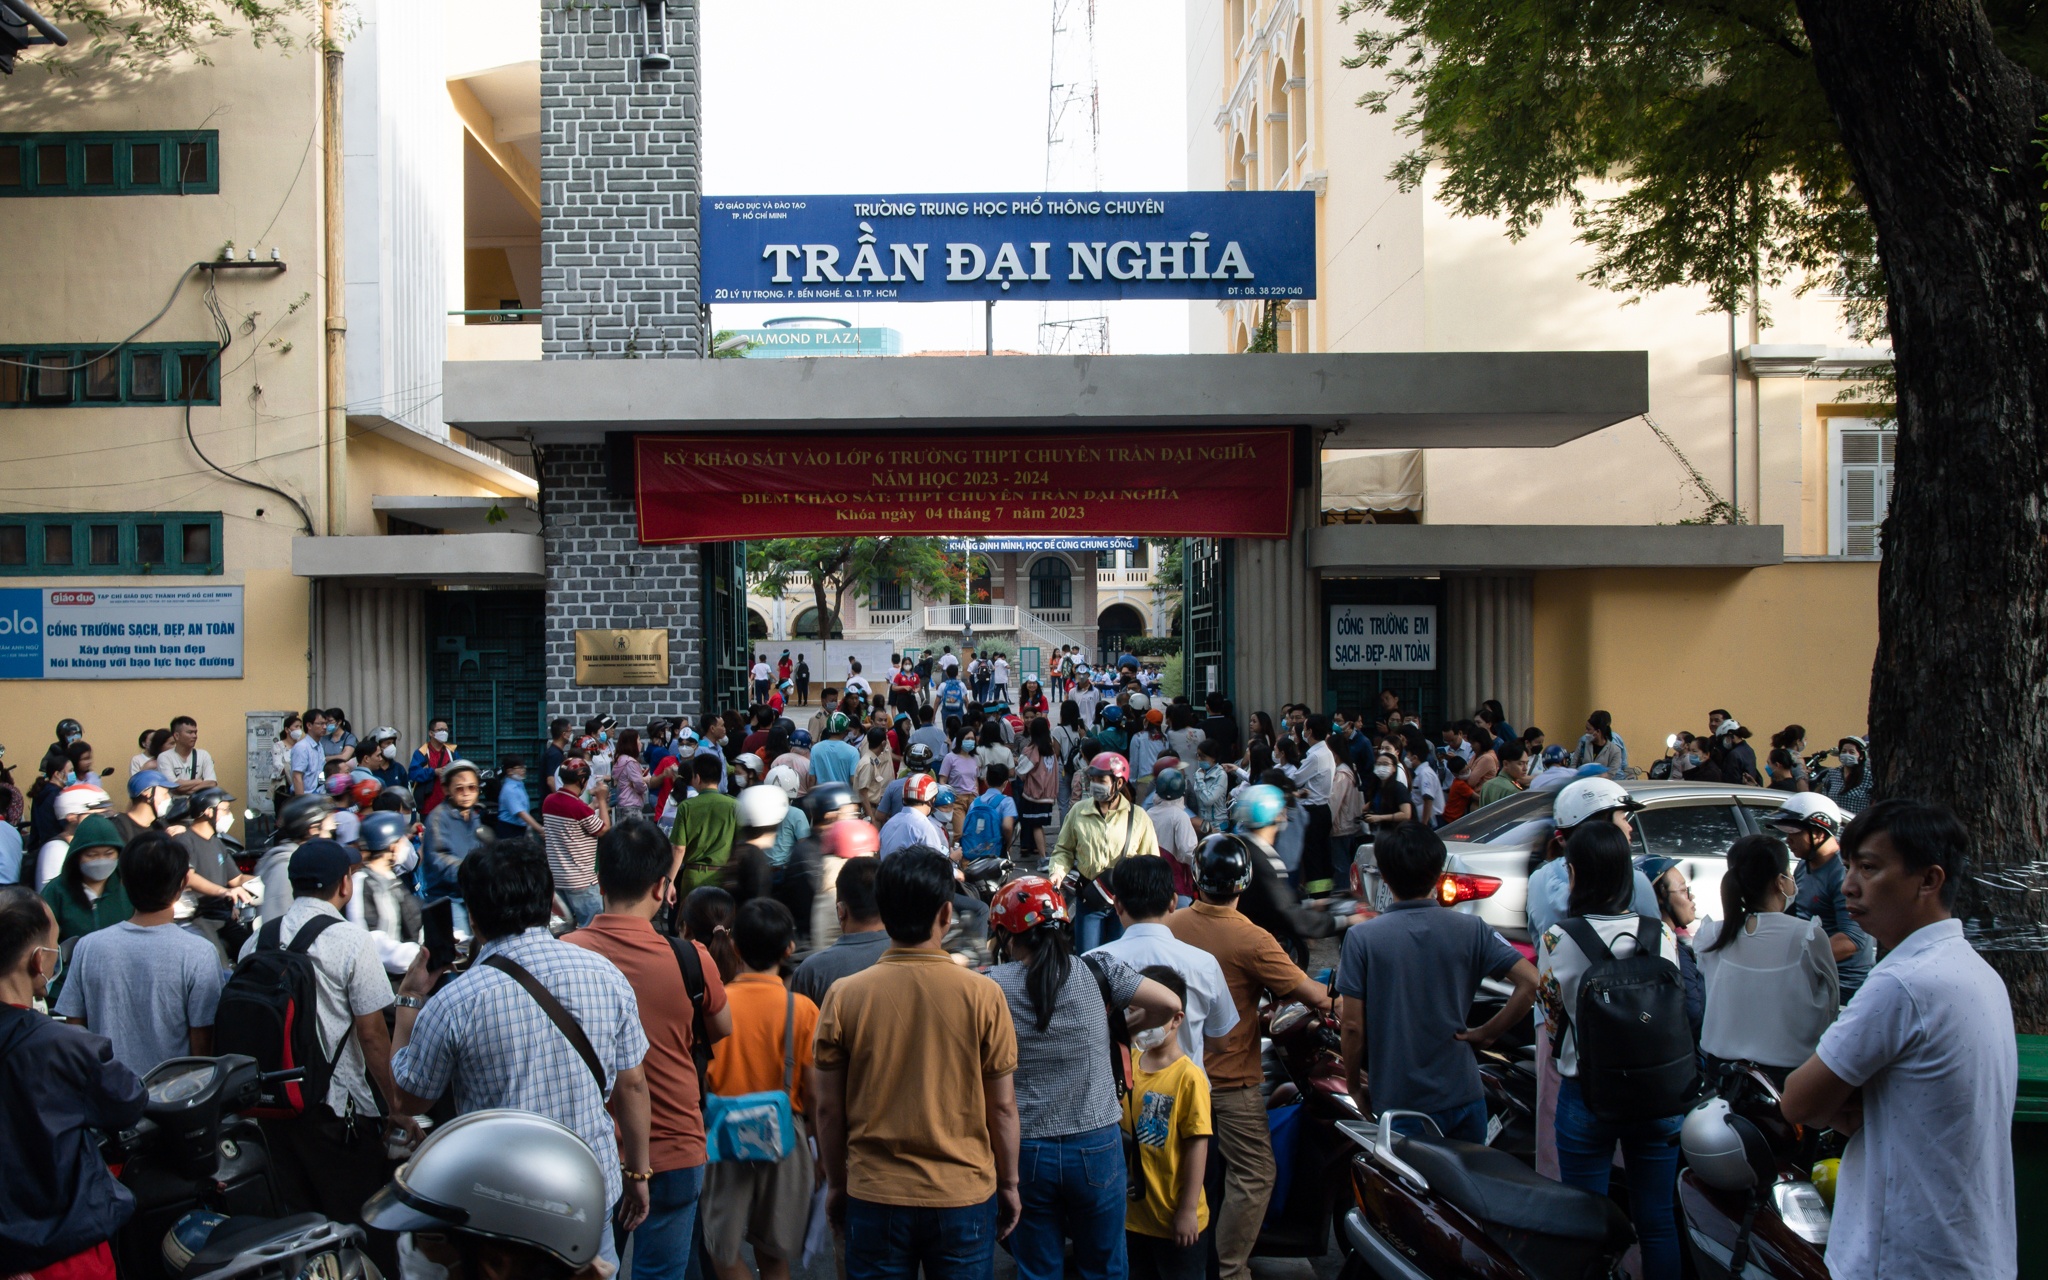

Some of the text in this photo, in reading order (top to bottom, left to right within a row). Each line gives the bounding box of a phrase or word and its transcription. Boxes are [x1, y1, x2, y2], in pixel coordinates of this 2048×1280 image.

[725, 201, 745, 210] GIÁO
[746, 202, 761, 211] DỤC
[762, 201, 773, 209] VÀ
[774, 201, 790, 209] ĐÀO
[792, 202, 807, 211] TẠO
[854, 195, 1165, 218] TRƯỜNG TRUNG HỌC PHỔ THÔNG CHUYÊN
[732, 212, 741, 220] TP.
[755, 210, 768, 220] CHÍ
[761, 221, 1256, 292] TRẦN ĐẠI NGHĨA
[715, 288, 729, 299] 20
[730, 288, 740, 299] LÝ
[741, 290, 752, 300] TỰ
[753, 290, 785, 300] TRỌNG.
[788, 290, 796, 298] P.
[815, 287, 842, 298] NGHÉ.
[844, 289, 855, 298] Q.
[856, 290, 862, 298] 1.
[863, 290, 874, 298] TP.
[1227, 287, 1239, 295] ĐT
[1244, 287, 1257, 295] 08.
[1259, 287, 1269, 295] 38
[1271, 287, 1286, 295] 229
[1287, 287, 1303, 295] 040
[815, 332, 862, 345] PLAZA
[752, 448, 787, 466] SÁT
[791, 447, 831, 466] VÀO
[835, 447, 872, 466] LỚP
[875, 451, 885, 465] 6
[888, 446, 967, 465] TRƯỜNG
[972, 449, 1021, 464] THPT
[1024, 444, 1101, 464] CHUYÊN
[1160, 446, 1193, 465] ĐẠI
[1197, 442, 1257, 460] NGHĨA
[871, 469, 913, 487] NĂM
[919, 471, 960, 489] HỌC
[963, 471, 999, 486] 2023
[1013, 470, 1049, 486] 2024
[852, 490, 891, 503] SÁT:
[895, 491, 944, 503] THPT
[948, 488, 1024, 503] CHUYÊN
[1083, 489, 1115, 503] ĐẠI
[1119, 486, 1180, 501] NGHĨA
[835, 506, 1086, 523] Khóa ngày 04 tháng 7 năm 2023
[979, 542, 999, 552] ĐỊNH
[1000, 539, 1025, 551] MÌNH,
[1025, 541, 1043, 551] HỌC
[1056, 539, 1079, 549] CÙNG
[1079, 540, 1109, 549] CHUNG
[52, 592, 95, 604] giáo dục
[46, 620, 235, 638] CỔNG TRƯỜNG SẠCH, ĐẸP, AN TOÀN
[1337, 608, 1429, 635] CỔNG TRƯỜNG EM
[79, 645, 99, 656] Xây
[134, 644, 156, 654] tình
[159, 644, 181, 655] bạn
[184, 644, 206, 655] đẹp
[1404, 639, 1430, 662] TOÀN
[50, 656, 235, 668] Nói không với bạo lực học đường
